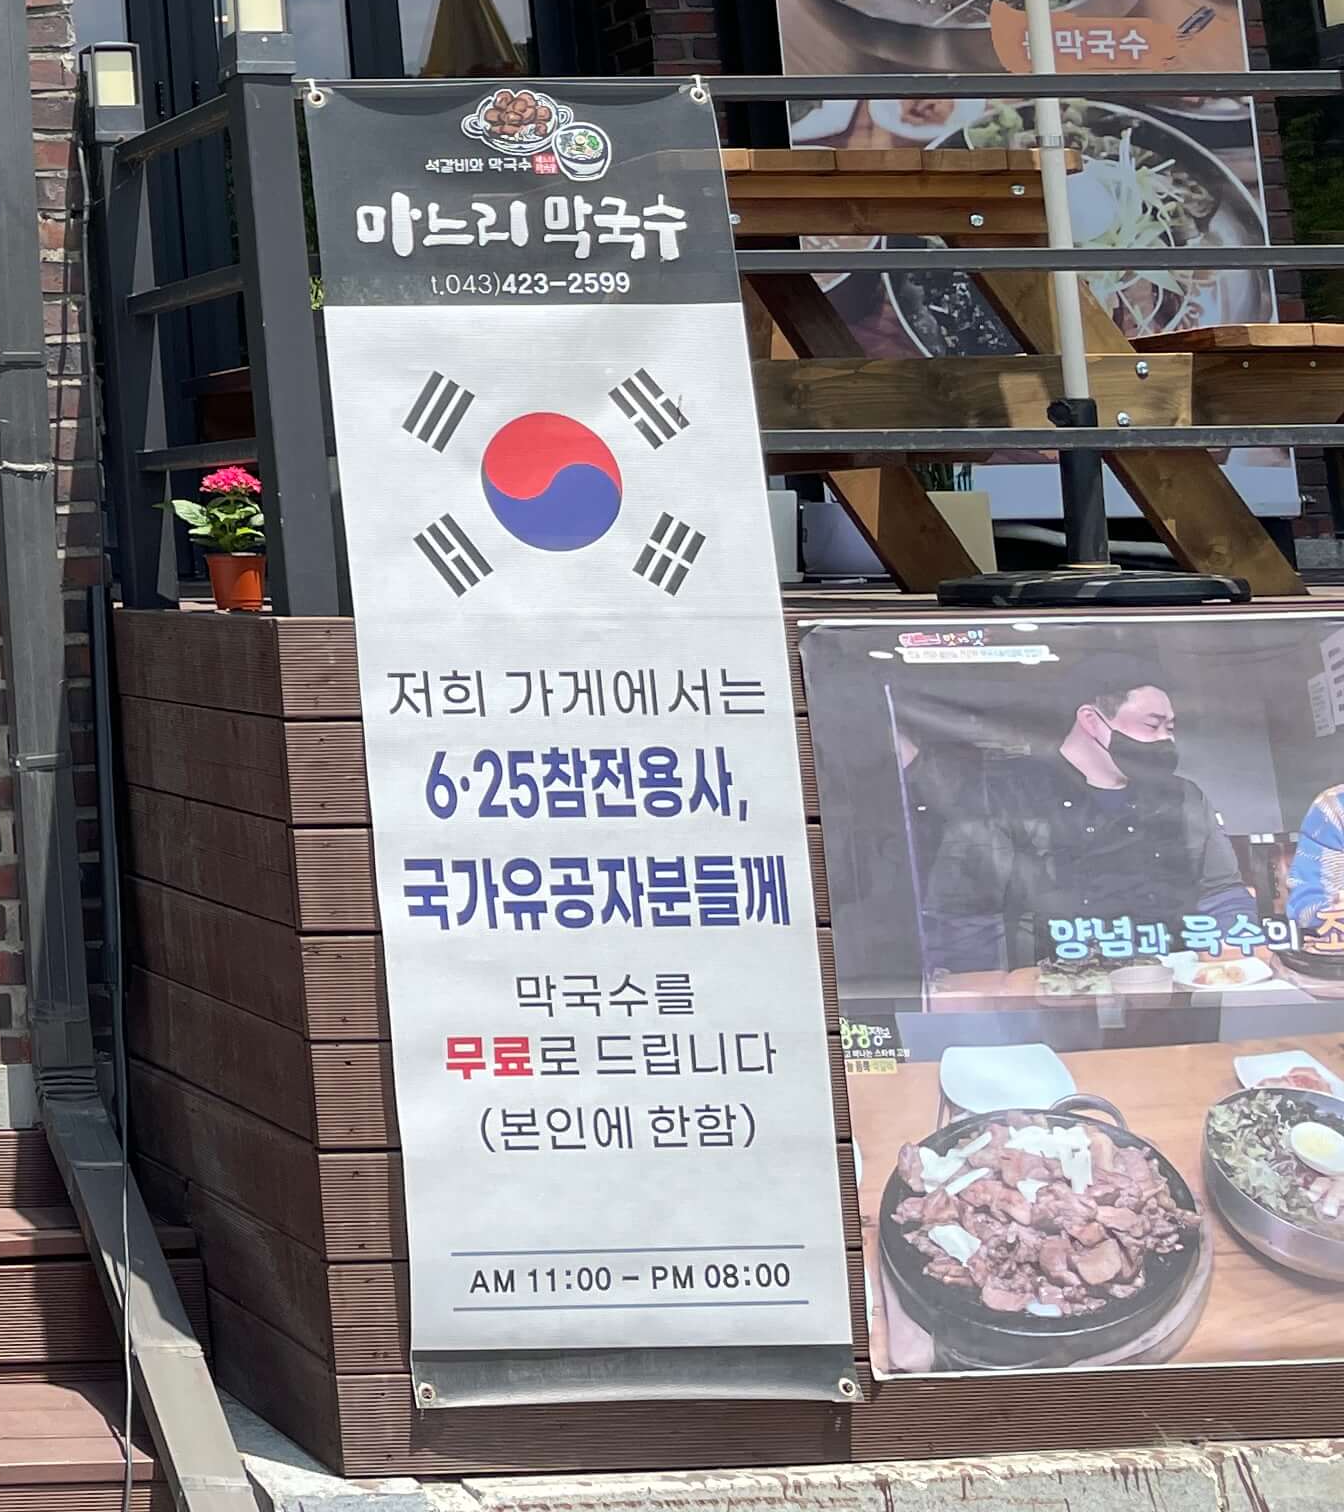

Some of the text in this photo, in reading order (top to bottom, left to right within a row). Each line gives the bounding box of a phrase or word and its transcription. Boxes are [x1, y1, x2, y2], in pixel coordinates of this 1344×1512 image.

[425, 157, 485, 174] 석갈비와
[488, 157, 532, 173] 막국수
[355, 191, 688, 261] 마느리 막국수
[430, 271, 631, 297] t.043)423-2599
[387, 668, 766, 719] 저희 가게에서는
[403, 854, 791, 931] 국가유공자분들께
[1047, 915, 1173, 959] 양념과
[516, 973, 696, 1018] 막국수를
[446, 1031, 777, 1081] 무료로 드립니다
[480, 1103, 758, 1153] (본인에 한함)
[469, 1269, 515, 1294] AM
[527, 1266, 611, 1293] 11:00
[651, 1265, 695, 1290] PM
[704, 1262, 791, 1288] 08:00
